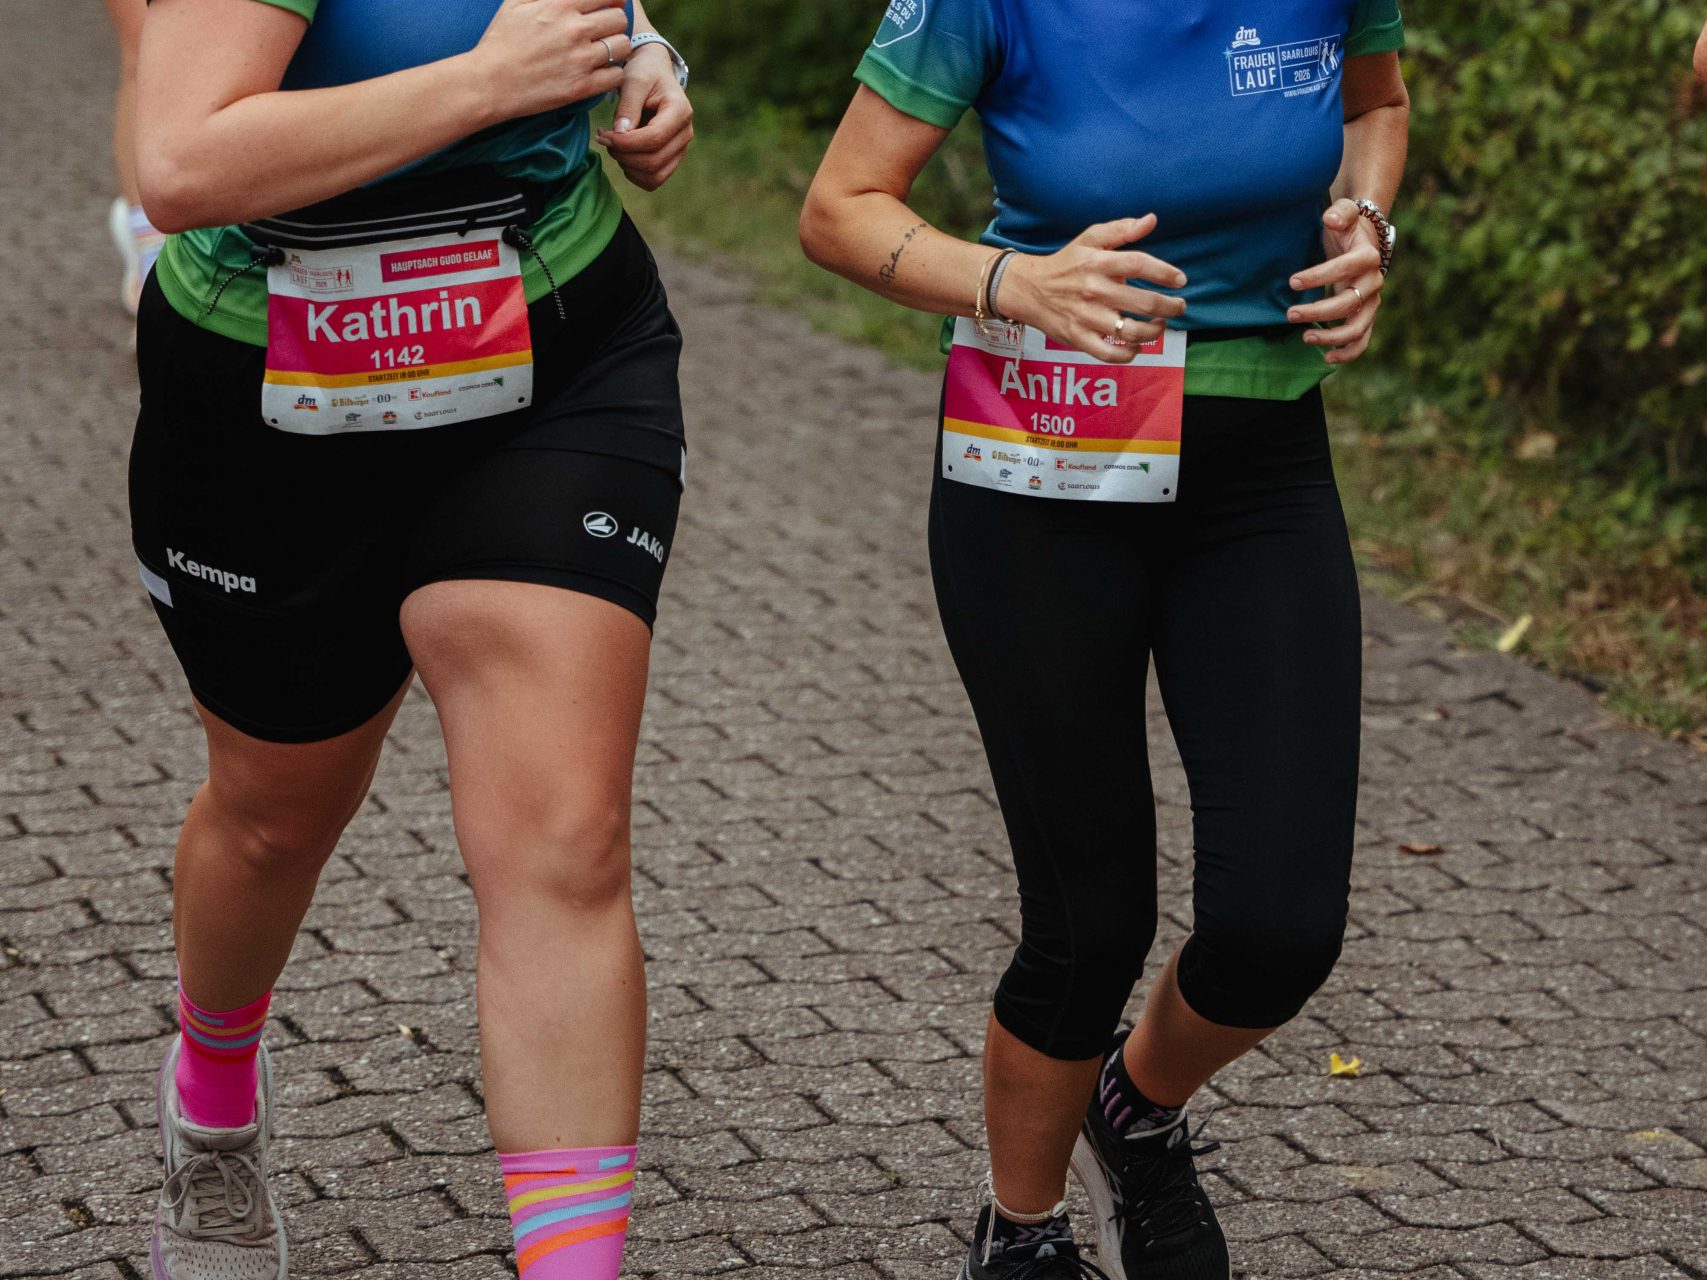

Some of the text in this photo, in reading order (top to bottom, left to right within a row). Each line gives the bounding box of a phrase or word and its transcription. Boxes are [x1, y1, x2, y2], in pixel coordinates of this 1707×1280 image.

[900, 6, 911, 20] DU
[1235, 25, 1257, 40] dm
[1233, 45, 1319, 71] FRAUEN SAARLOUIS
[1235, 67, 1277, 91] LAUF
[391, 257, 438, 273] HAUPTSACH
[463, 249, 493, 263] GELAAF
[307, 290, 483, 343] Kathrin
[370, 345, 426, 369] 1142
[422, 389, 452, 399] Kaufland
[1000, 360, 1118, 407] Anika
[297, 394, 316, 405] dm
[1031, 412, 1075, 436] 1500
[966, 443, 981, 455] dm
[1068, 463, 1096, 471] Kaufland
[626, 526, 664, 564] JAKO
[166, 547, 257, 593] Kempa
